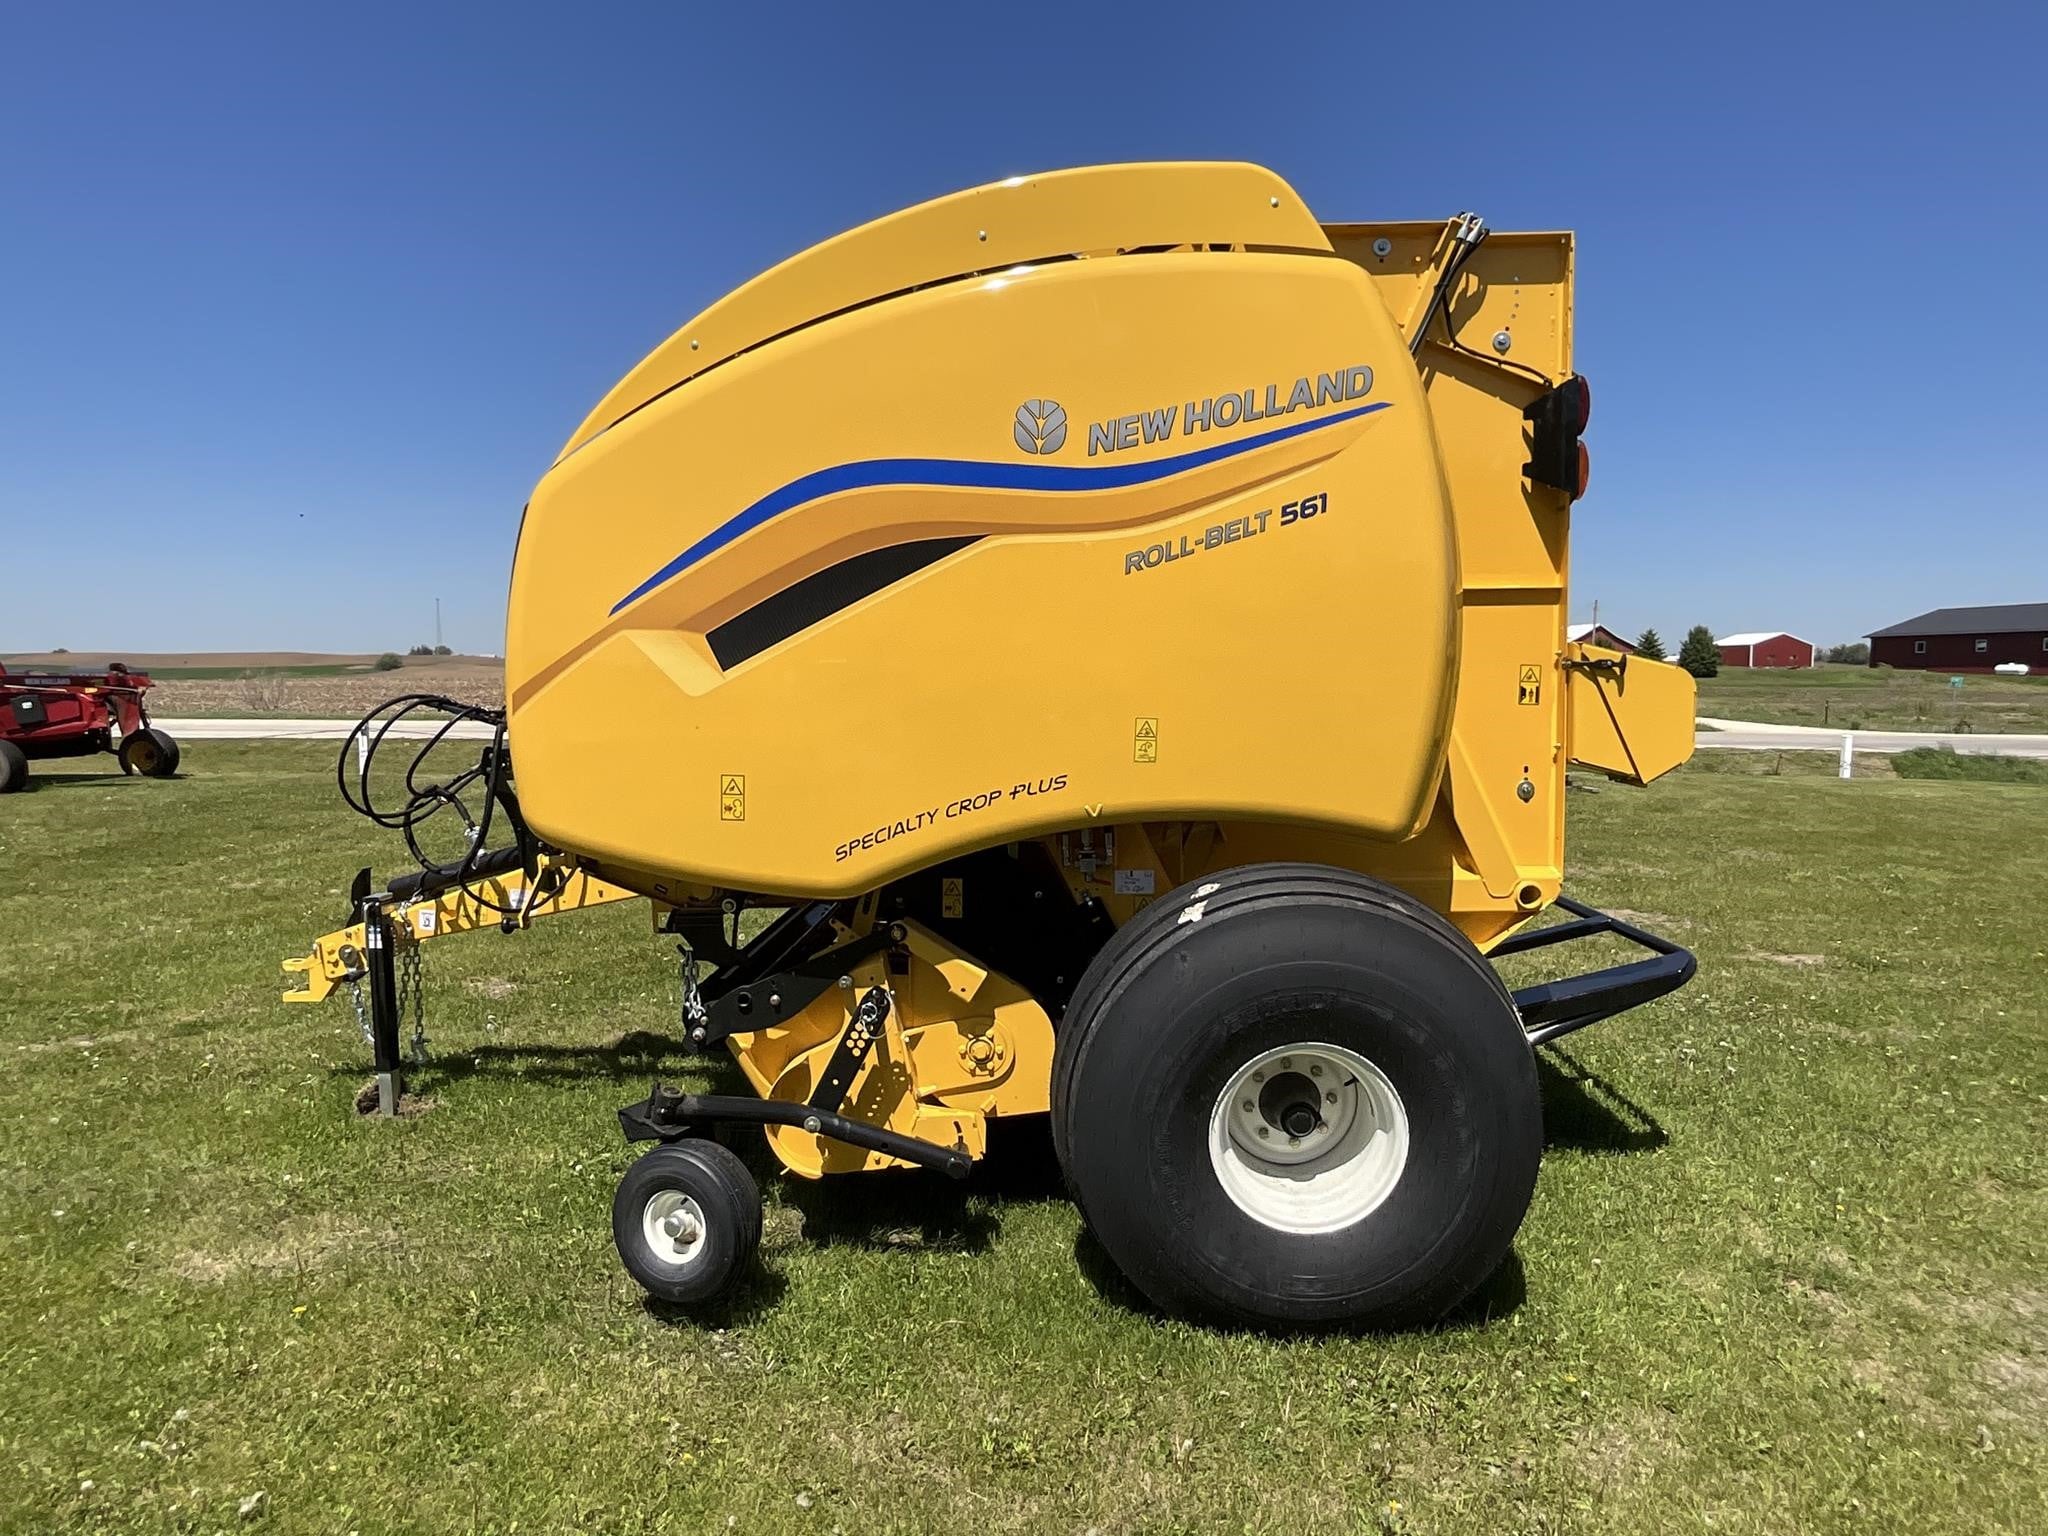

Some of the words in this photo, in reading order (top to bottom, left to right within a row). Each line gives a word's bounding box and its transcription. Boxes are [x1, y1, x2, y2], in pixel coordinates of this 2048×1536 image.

[1088, 405, 1178, 456] NEW
[1183, 364, 1374, 436] HOLLAND
[1124, 509, 1273, 575] ROLL-BELT
[1280, 492, 1328, 526] 561
[835, 808, 940, 862] SPECIALTY
[945, 789, 1002, 818] CROP
[1008, 774, 1068, 801] PLUS
